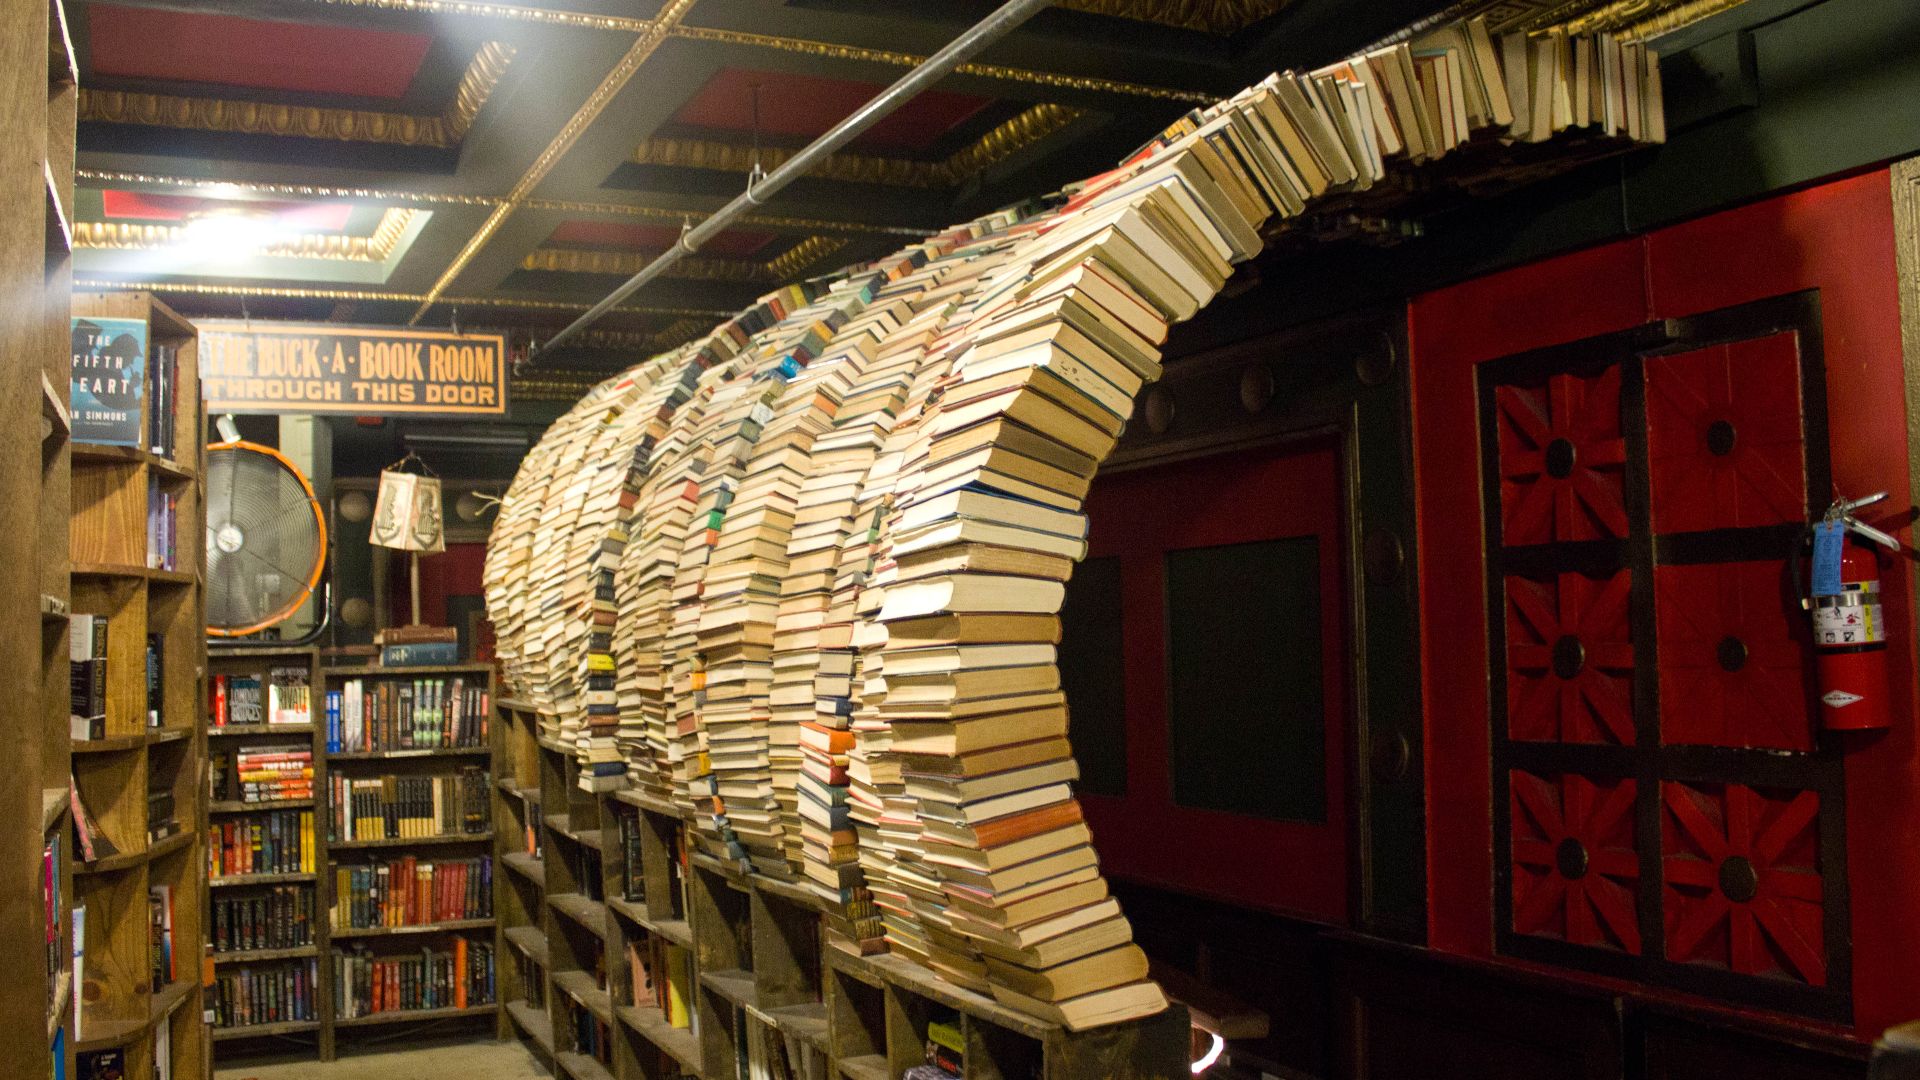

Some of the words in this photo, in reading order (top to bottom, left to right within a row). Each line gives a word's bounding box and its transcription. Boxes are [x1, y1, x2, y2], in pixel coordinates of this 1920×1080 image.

[88, 334, 111, 346] THE
[73, 354, 123, 369] FIFTH
[207, 336, 253, 376] THE
[257, 337, 322, 378] BUCK
[359, 340, 424, 382] BOOK
[429, 343, 494, 384] ROOM
[207, 377, 342, 401] THROUGH
[351, 382, 416, 402] THIS
[425, 383, 496, 405] DOOR
[86, 410, 127, 421] SIMMONS
